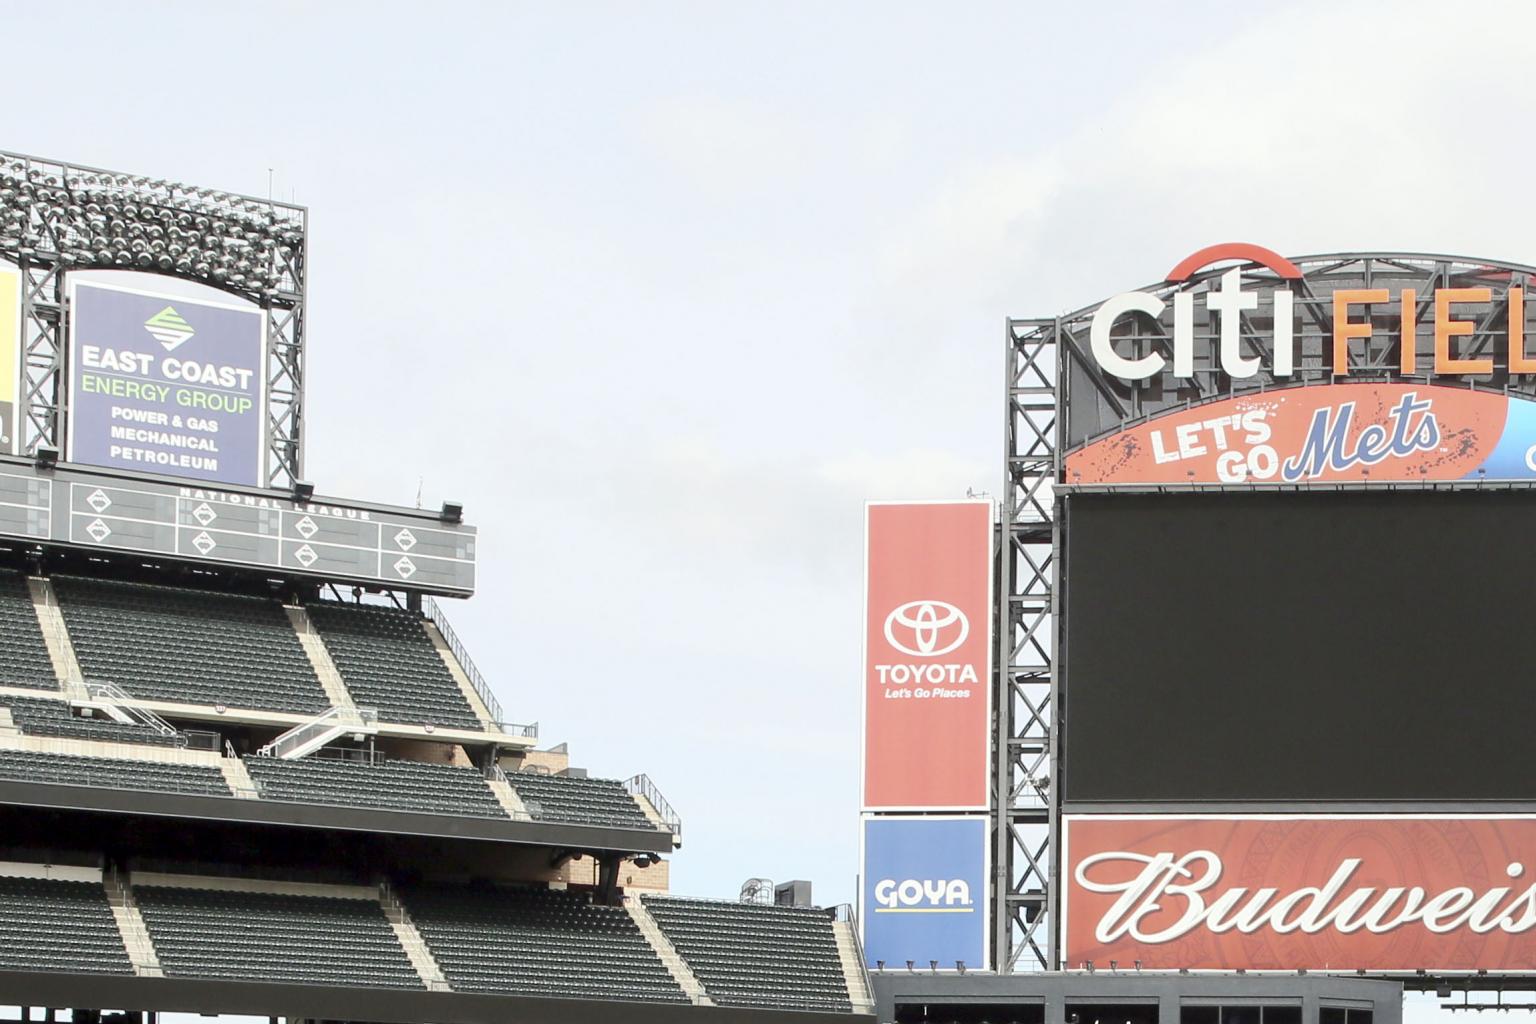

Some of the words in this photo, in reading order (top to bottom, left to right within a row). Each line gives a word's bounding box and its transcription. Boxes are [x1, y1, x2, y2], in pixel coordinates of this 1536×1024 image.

[1091, 262, 1293, 380] citi
[82, 345, 154, 375] EAST
[162, 357, 253, 390] COAST
[82, 374, 170, 403] ENERGY
[176, 388, 252, 415] GROUP
[111, 406, 168, 427] POWER
[171, 415, 183, 428] &
[186, 417, 218, 432] GAS
[1150, 409, 1272, 464] LET'S
[1281, 392, 1442, 482] Mets
[111, 425, 219, 453] MECHANICAL
[110, 445, 218, 472] PETROLEUM
[1216, 444, 1279, 484] GO
[179, 487, 282, 509] NATIONAL
[294, 502, 370, 521] LEAGUE
[875, 663, 978, 684] TOYOTA
[885, 688, 912, 699] Let's
[914, 687, 931, 698] Go
[932, 687, 970, 698] Places
